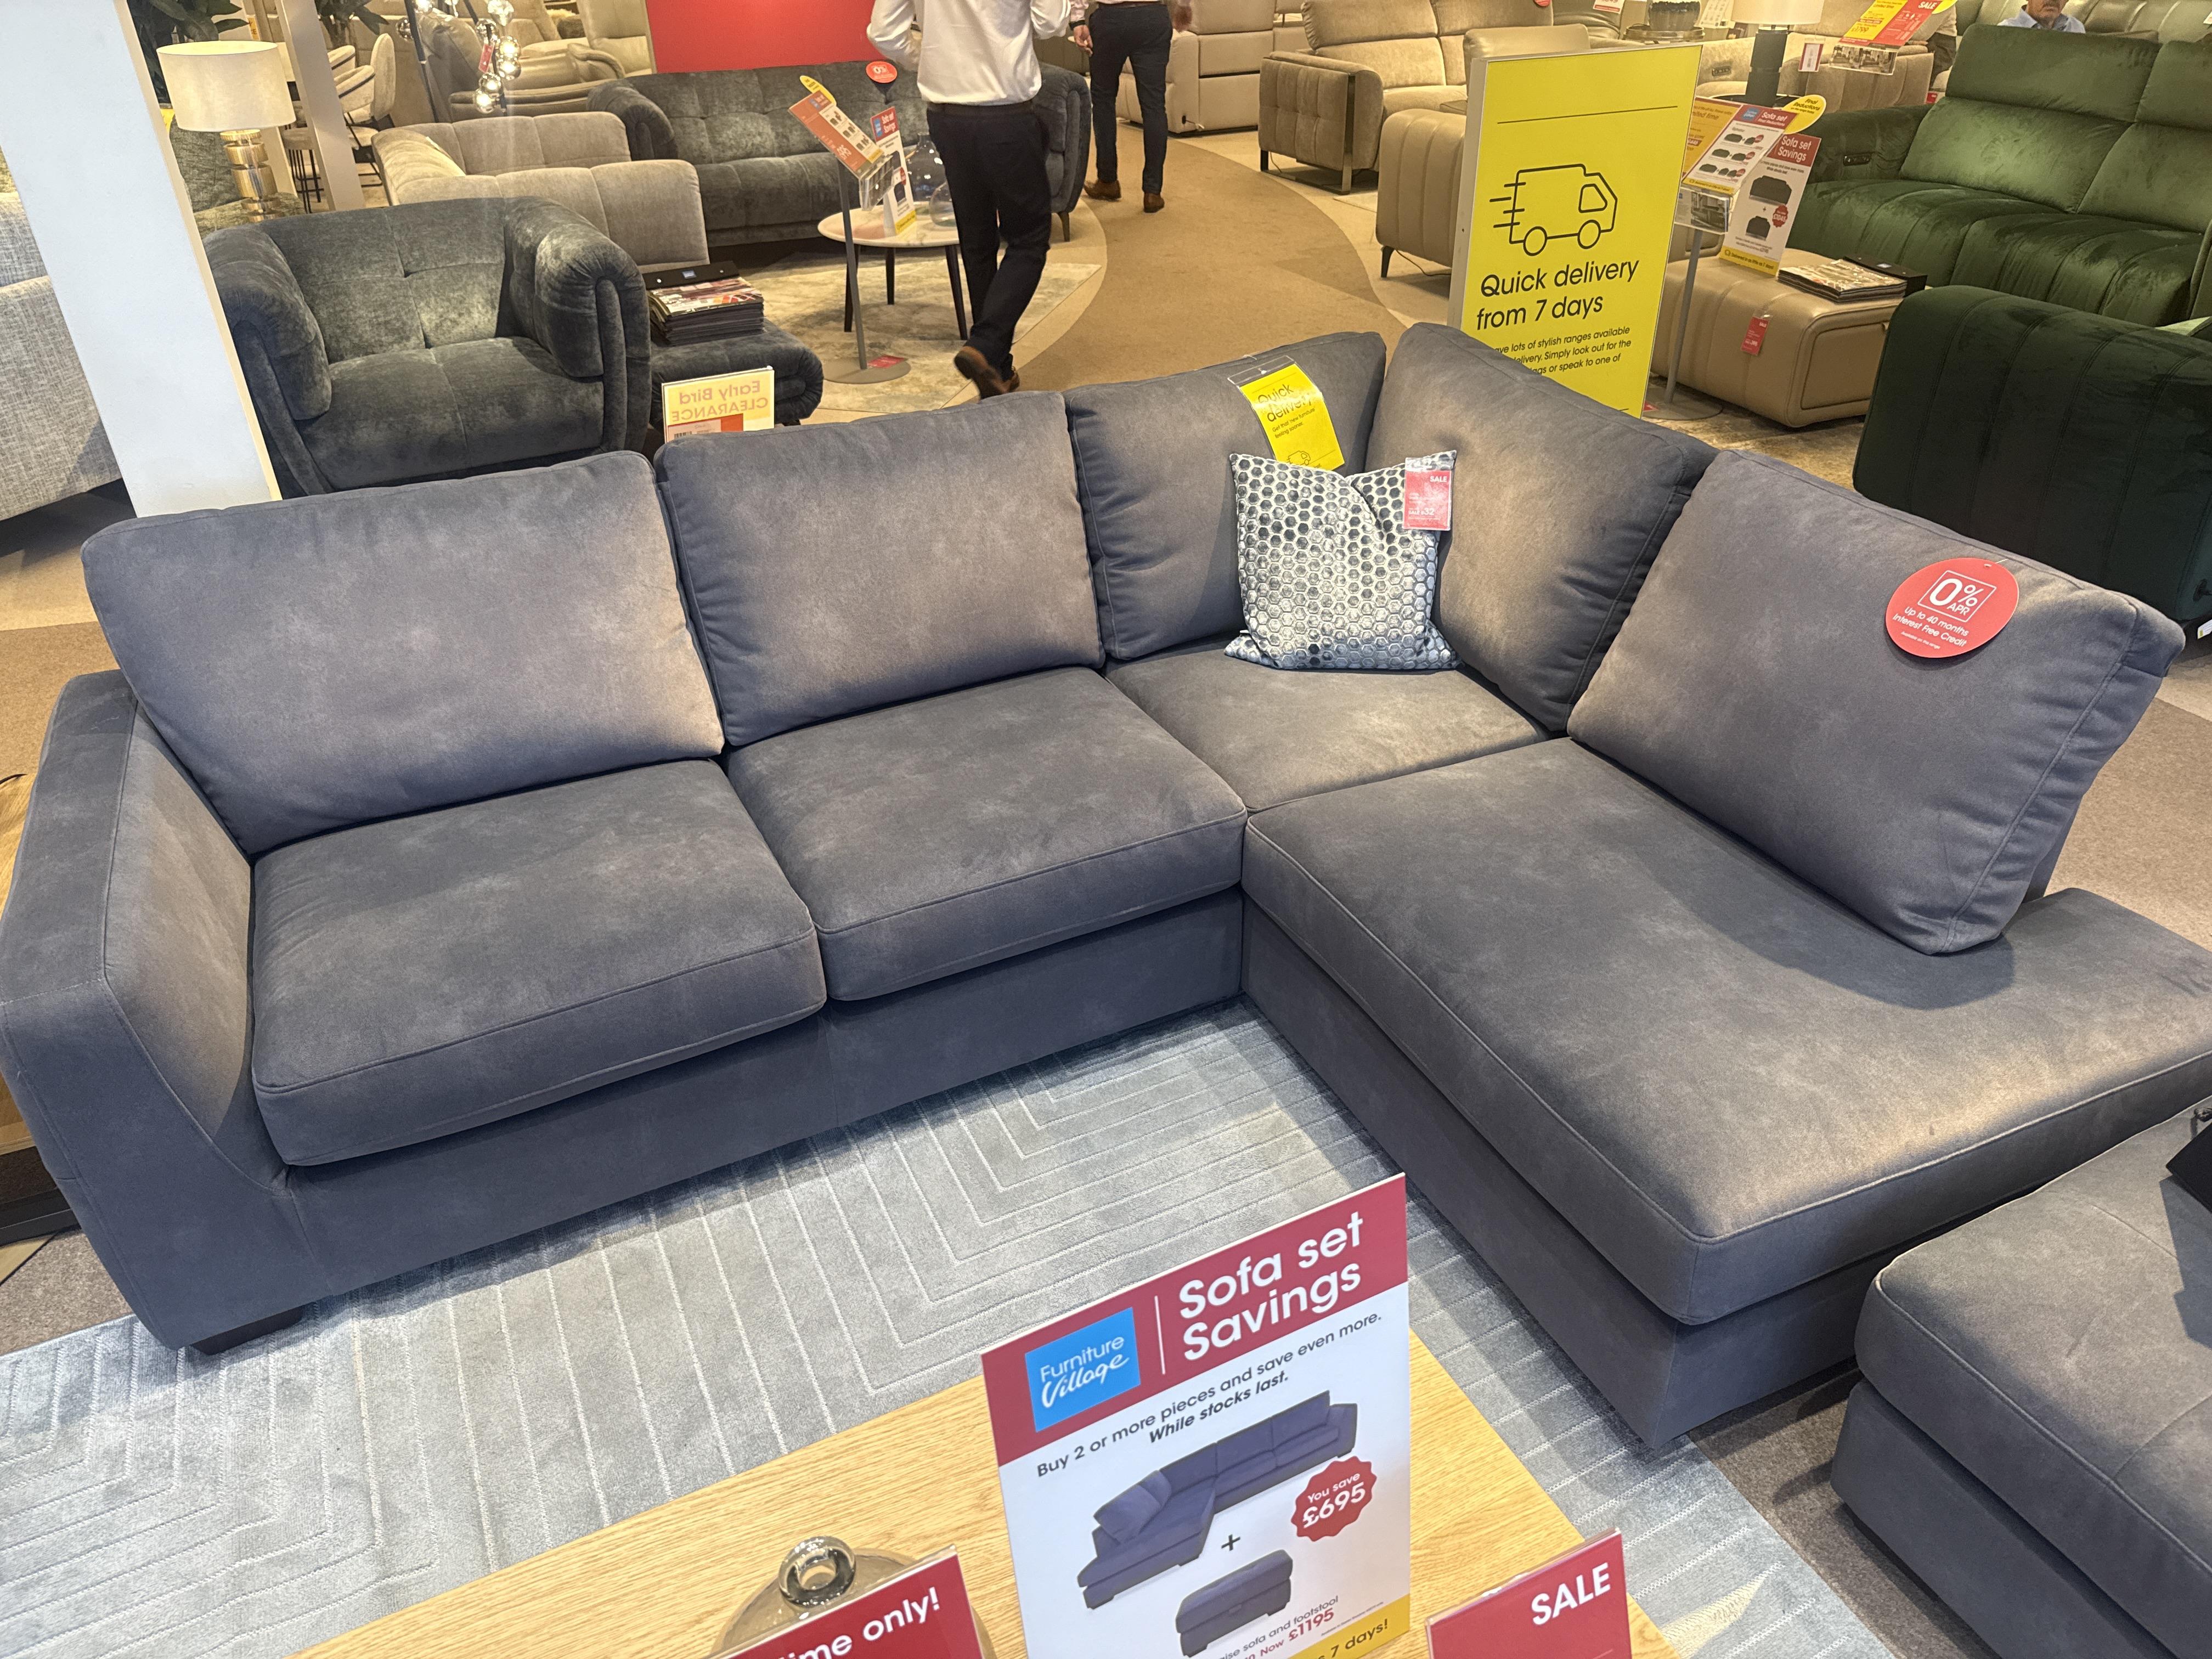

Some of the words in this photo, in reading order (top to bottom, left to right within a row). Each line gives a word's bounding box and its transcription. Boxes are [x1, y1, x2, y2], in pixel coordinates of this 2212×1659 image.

[1918, 1, 1938, 9] SALE
[1761, 111, 1776, 120] Sofa
[1778, 146, 1807, 163] Savings
[1781, 136, 1798, 148] Sofa
[1798, 140, 1812, 151] set
[1481, 268, 1548, 297] Quick
[1554, 260, 1639, 286] delivery
[1476, 307, 1526, 330] from
[1534, 299, 1547, 321] 7
[1551, 296, 1604, 320] days
[1511, 342, 1526, 352] lots
[1527, 340, 1537, 349] of
[1538, 336, 1561, 349] stylish
[1564, 332, 1592, 343] ranges
[1593, 326, 1630, 338] available
[1514, 354, 1543, 364] elivery.
[1544, 349, 1571, 360] Simply
[1572, 346, 1590, 356] look
[1592, 343, 1605, 352] out
[1606, 342, 1617, 351] for
[1618, 340, 1632, 348] the
[1531, 367, 1547, 375] ags
[1559, 360, 1584, 372] speak
[1595, 357, 1611, 365] one
[1612, 353, 1622, 362] of
[1257, 384, 1294, 404] Quick
[1274, 429, 1289, 438] feeling
[1929, 578, 1984, 607] 0%
[1946, 602, 1970, 616] APR
[1893, 613, 1923, 630] Interest
[1922, 625, 1940, 636] Free
[1940, 632, 1967, 647] Credit
[1904, 606, 1916, 616] Up
[1917, 611, 1926, 619] to
[1927, 616, 1939, 624] 40
[1937, 620, 1969, 636] months
[1178, 1253, 1283, 1318] Sofa
[1297, 1211, 1364, 1268] set
[1183, 1263, 1361, 1361] Savings
[1040, 1336, 1125, 1383] Furniture
[1037, 1454, 1070, 1477] Buy
[1074, 1445, 1085, 1460] 2
[1090, 1436, 1108, 1452] or
[1111, 1415, 1156, 1443] more
[1160, 1386, 1216, 1424] pieces
[1220, 1367, 1253, 1392] and
[1256, 1351, 1294, 1376] save
[1297, 1333, 1335, 1356] even
[1339, 1313, 1382, 1339] more.
[1042, 1353, 1130, 1409] Village
[1148, 1413, 1195, 1443] While
[1199, 1389, 1251, 1421] stocks
[1255, 1371, 1289, 1395] last.
[1302, 1482, 1365, 1528] £695
[1307, 1488, 1329, 1503] You
[1333, 1473, 1361, 1492] save
[1531, 1562, 1611, 1626] SALE
[862, 1586, 940, 1641] only!
[1243, 1635, 1266, 1651] sofa
[1269, 1620, 1291, 1638] and
[1294, 1595, 1339, 1625] footstool
[1260, 1640, 1285, 1656] Now
[1289, 1607, 1334, 1641] £1195
[1330, 1645, 1339, 1658] 7
[1345, 1618, 1388, 1650] days!
